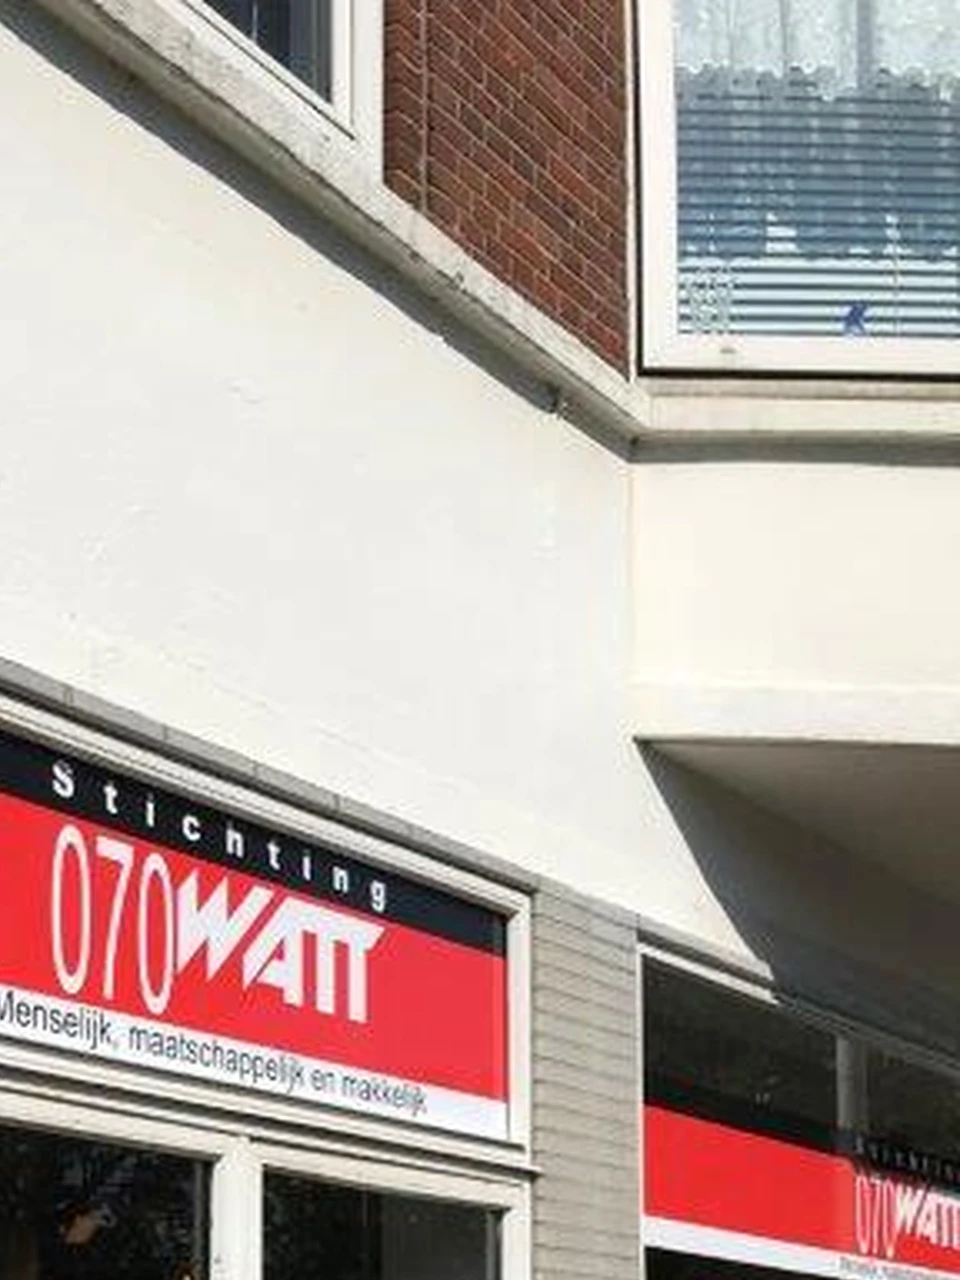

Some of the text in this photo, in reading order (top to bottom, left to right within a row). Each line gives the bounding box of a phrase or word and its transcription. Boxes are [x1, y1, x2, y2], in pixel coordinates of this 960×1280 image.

[52, 760, 386, 912] Stichting
[129, 1025, 305, 1094] maatschappelijk
[311, 1068, 335, 1093] en
